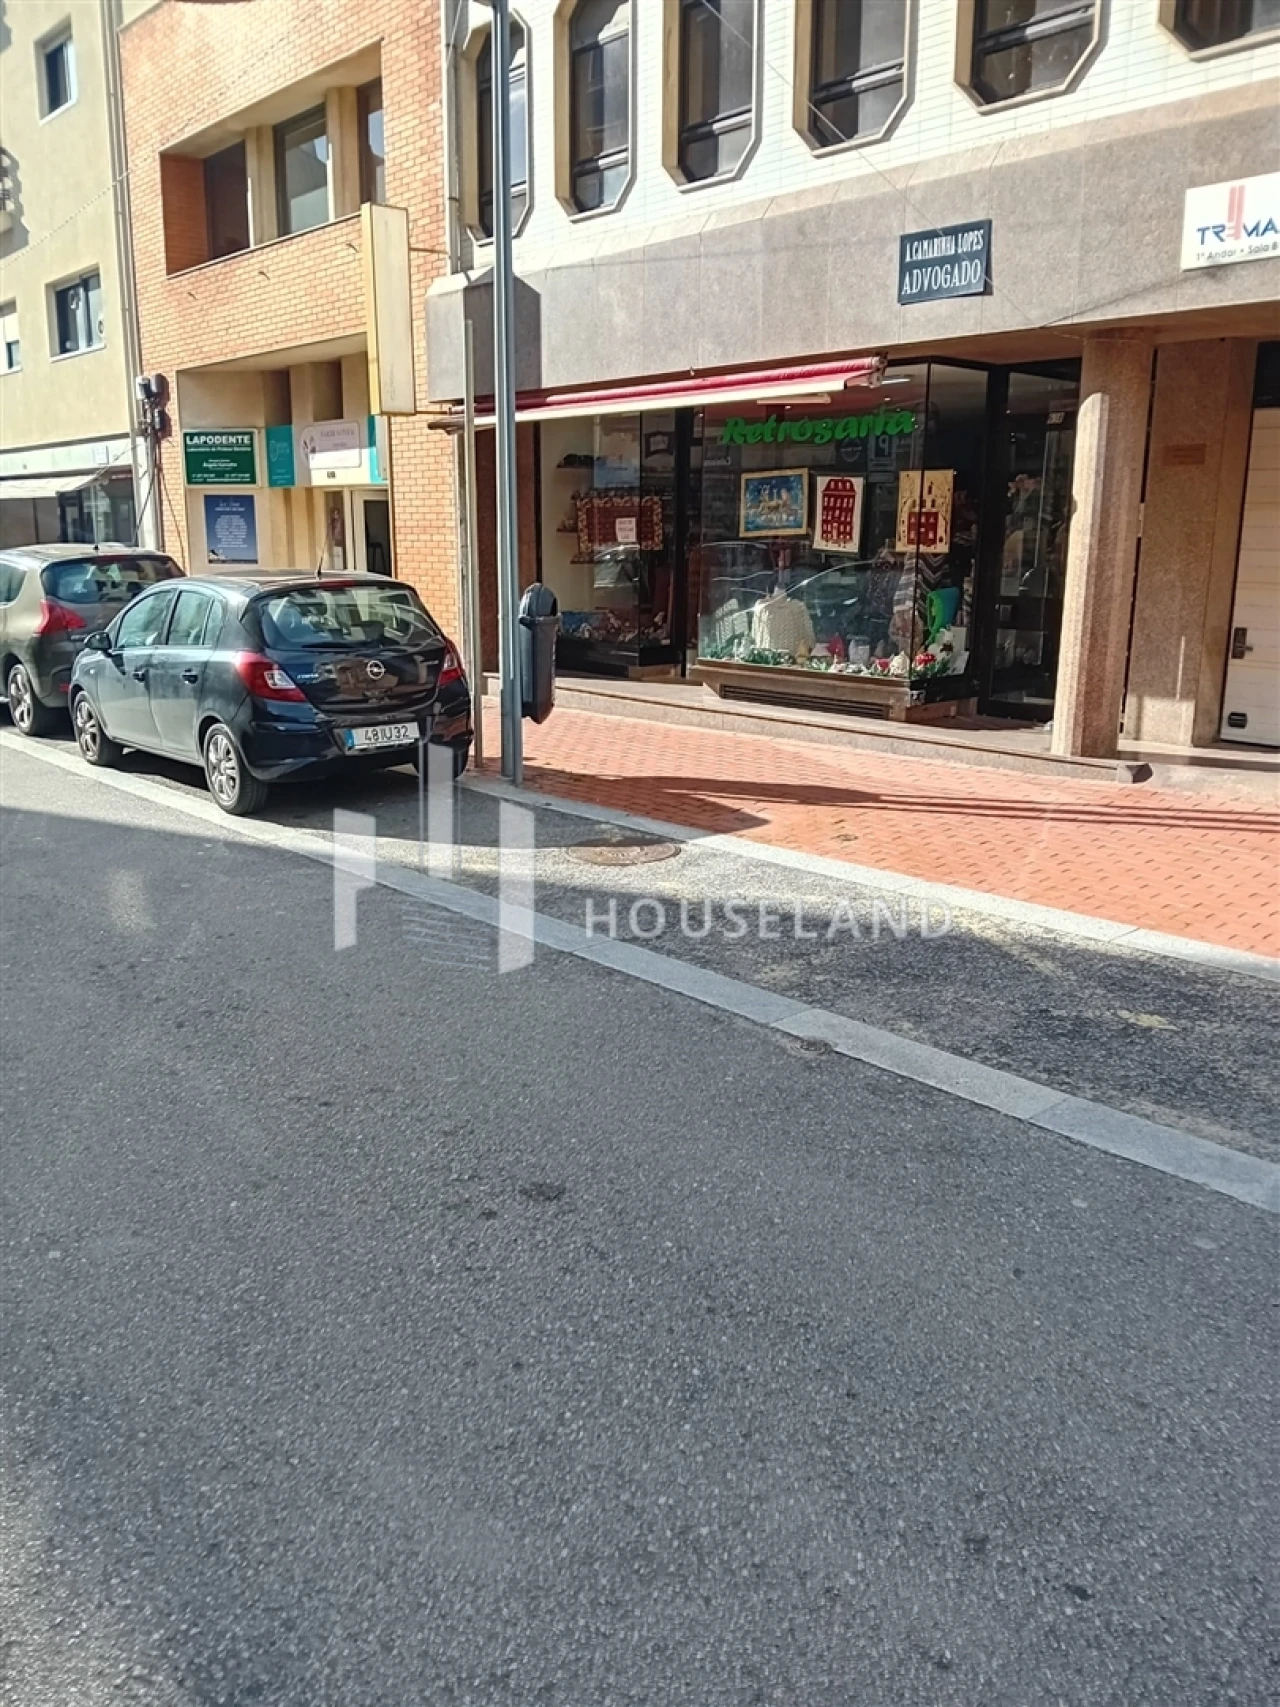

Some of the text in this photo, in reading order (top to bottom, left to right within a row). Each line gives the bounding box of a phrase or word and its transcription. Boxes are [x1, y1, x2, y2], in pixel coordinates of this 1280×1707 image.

[1207, 249, 1236, 260] Andar
[1248, 244, 1270, 254] Sala
[901, 258, 981, 295] ADVOGADO
[720, 406, 915, 445] Retrosaria
[186, 434, 251, 445] LAPODENTE
